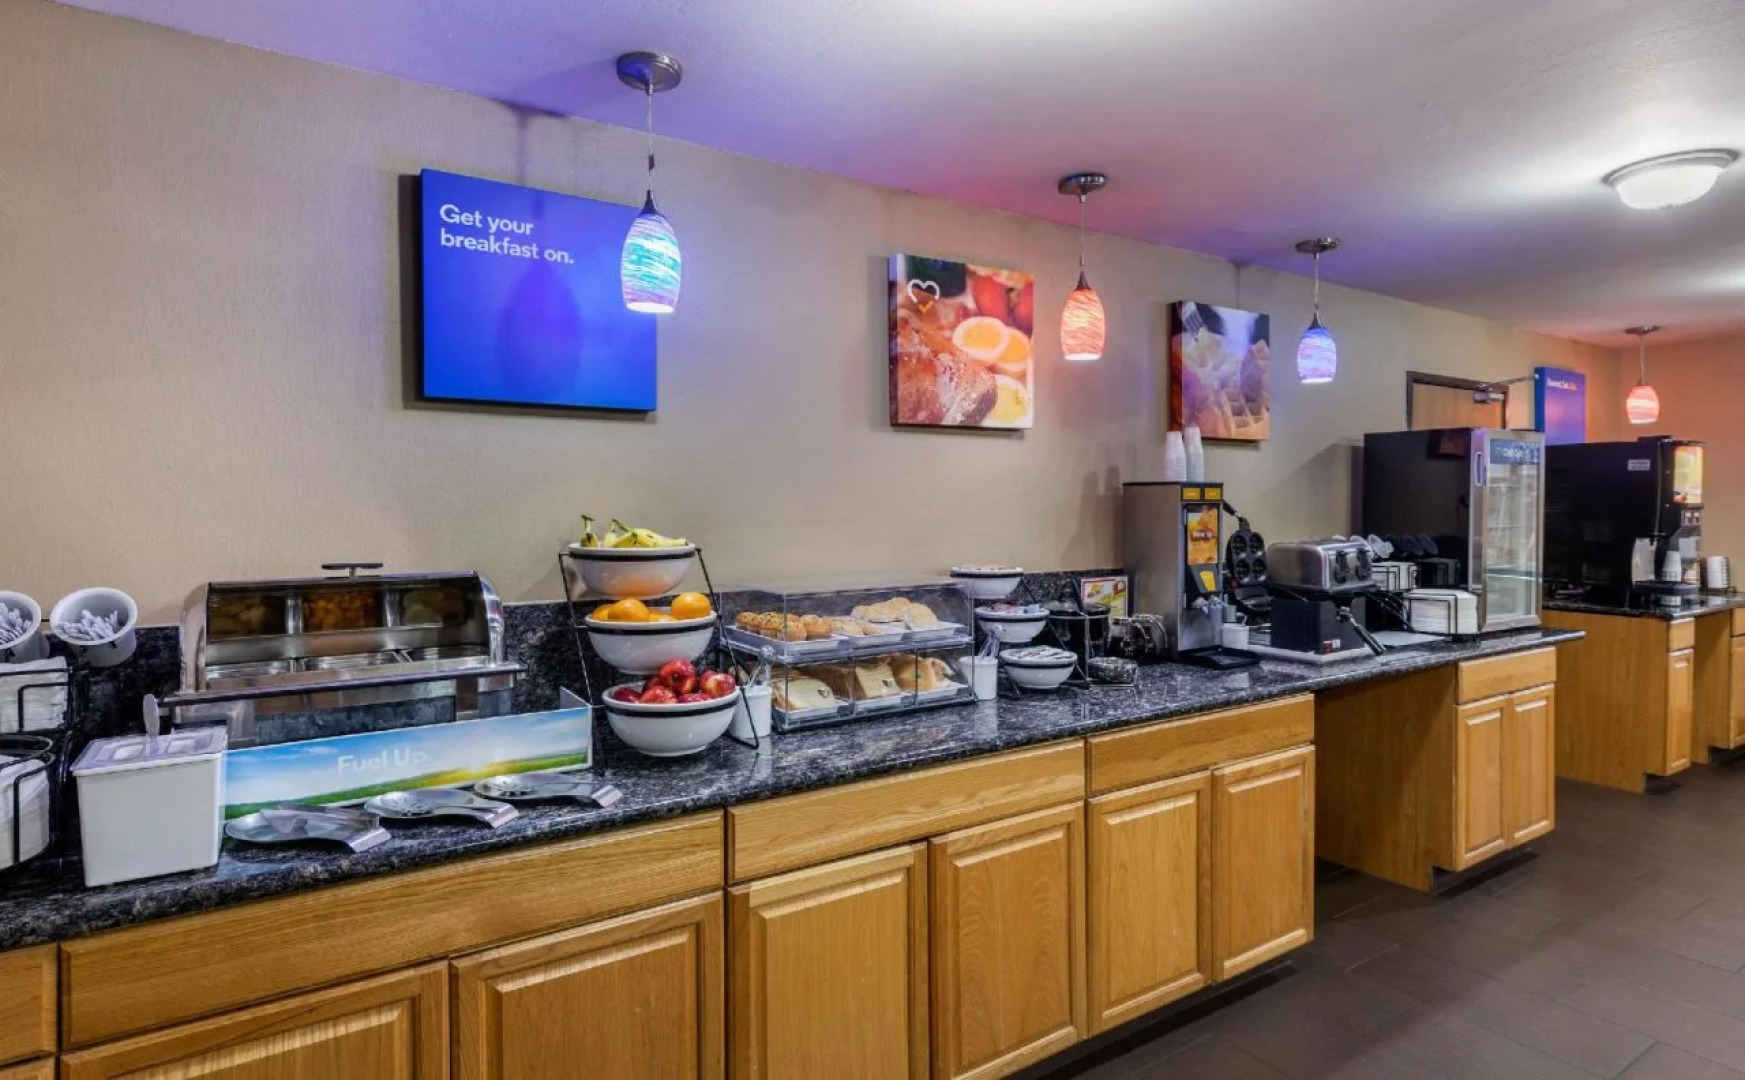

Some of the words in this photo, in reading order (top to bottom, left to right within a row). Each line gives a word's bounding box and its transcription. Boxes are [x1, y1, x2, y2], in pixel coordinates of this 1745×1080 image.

[440, 204, 482, 227] Get
[487, 216, 534, 235] your
[441, 228, 540, 259] breakfast
[543, 248, 575, 264] on.
[338, 750, 388, 776] Fuel
[393, 746, 427, 768] Up
